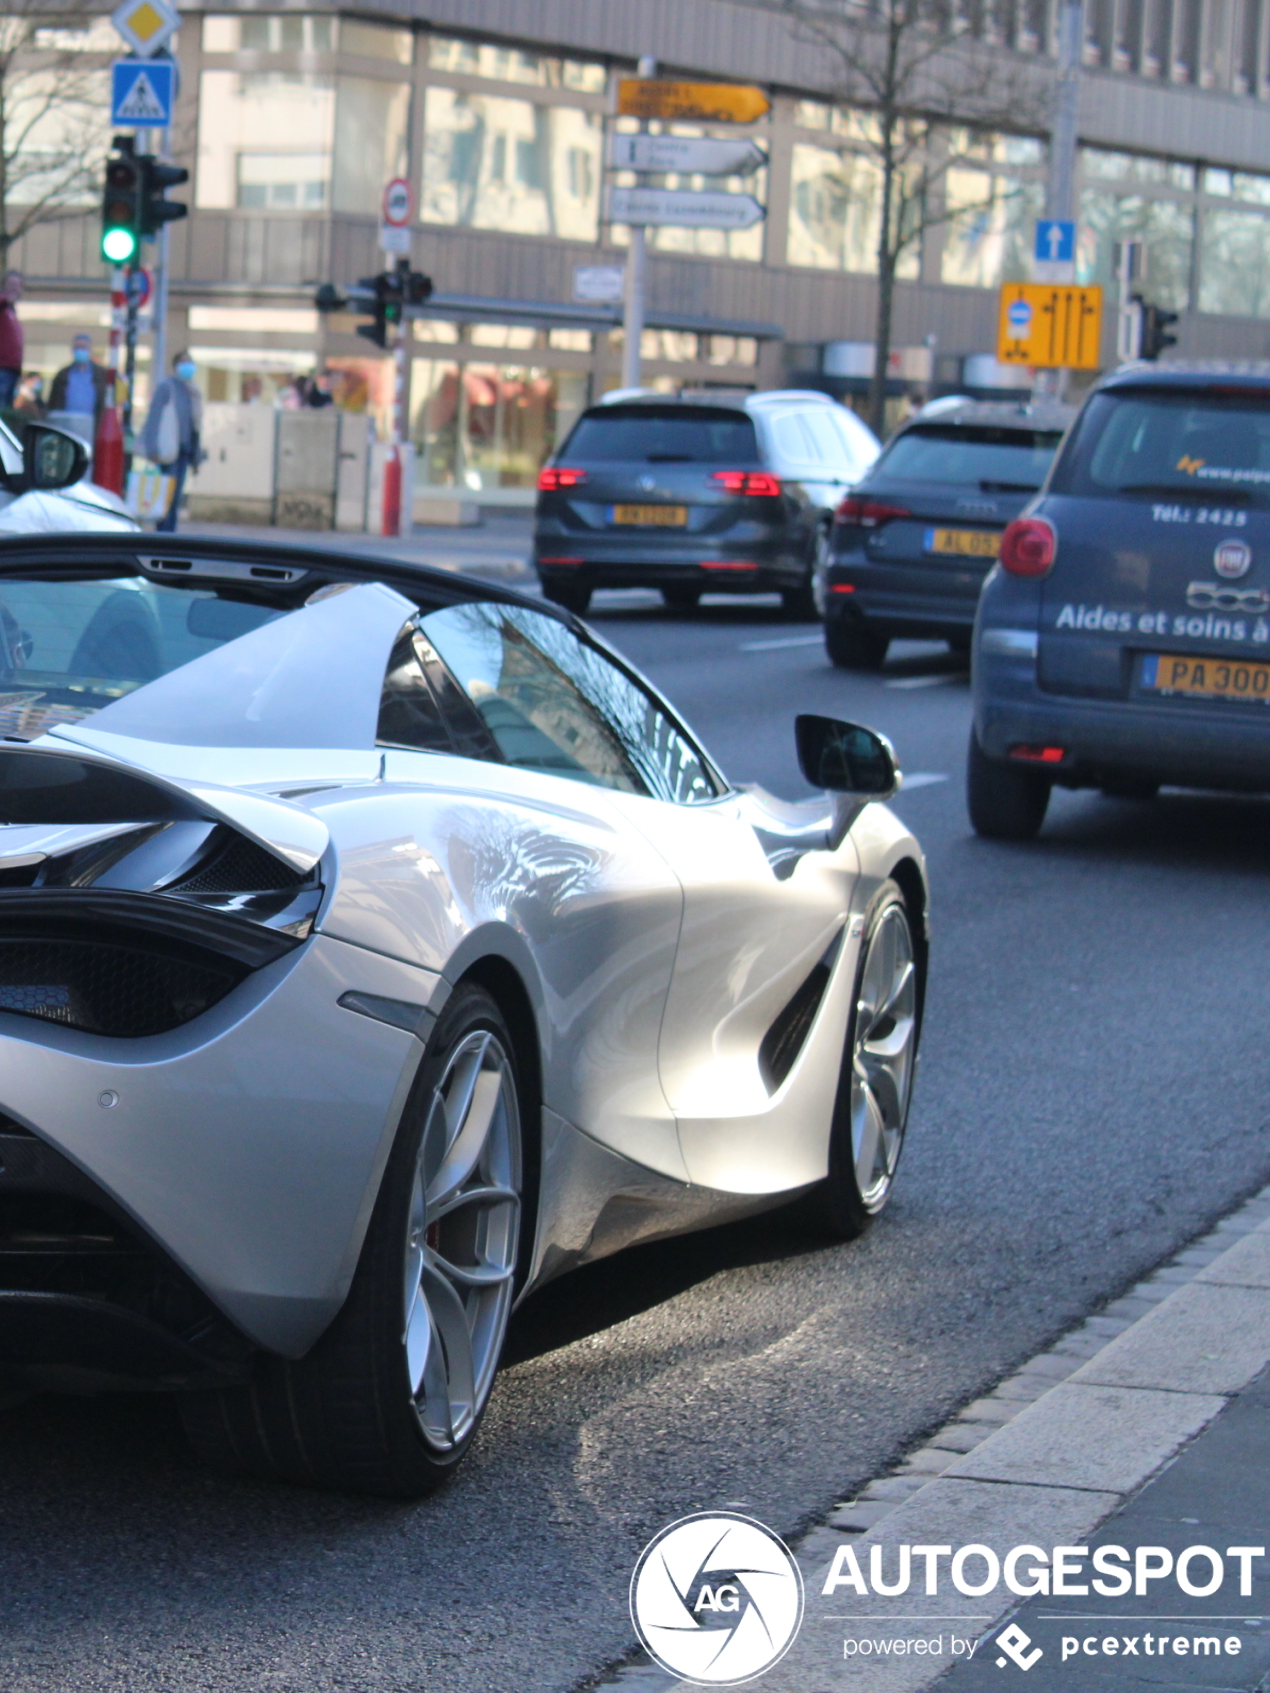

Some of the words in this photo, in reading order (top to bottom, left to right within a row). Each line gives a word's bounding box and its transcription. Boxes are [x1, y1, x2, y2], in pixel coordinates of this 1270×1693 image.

[1055, 603, 1132, 631] Aides
[1137, 610, 1168, 635] et
[1172, 611, 1246, 641] soins
[1171, 661, 1205, 688] PA
